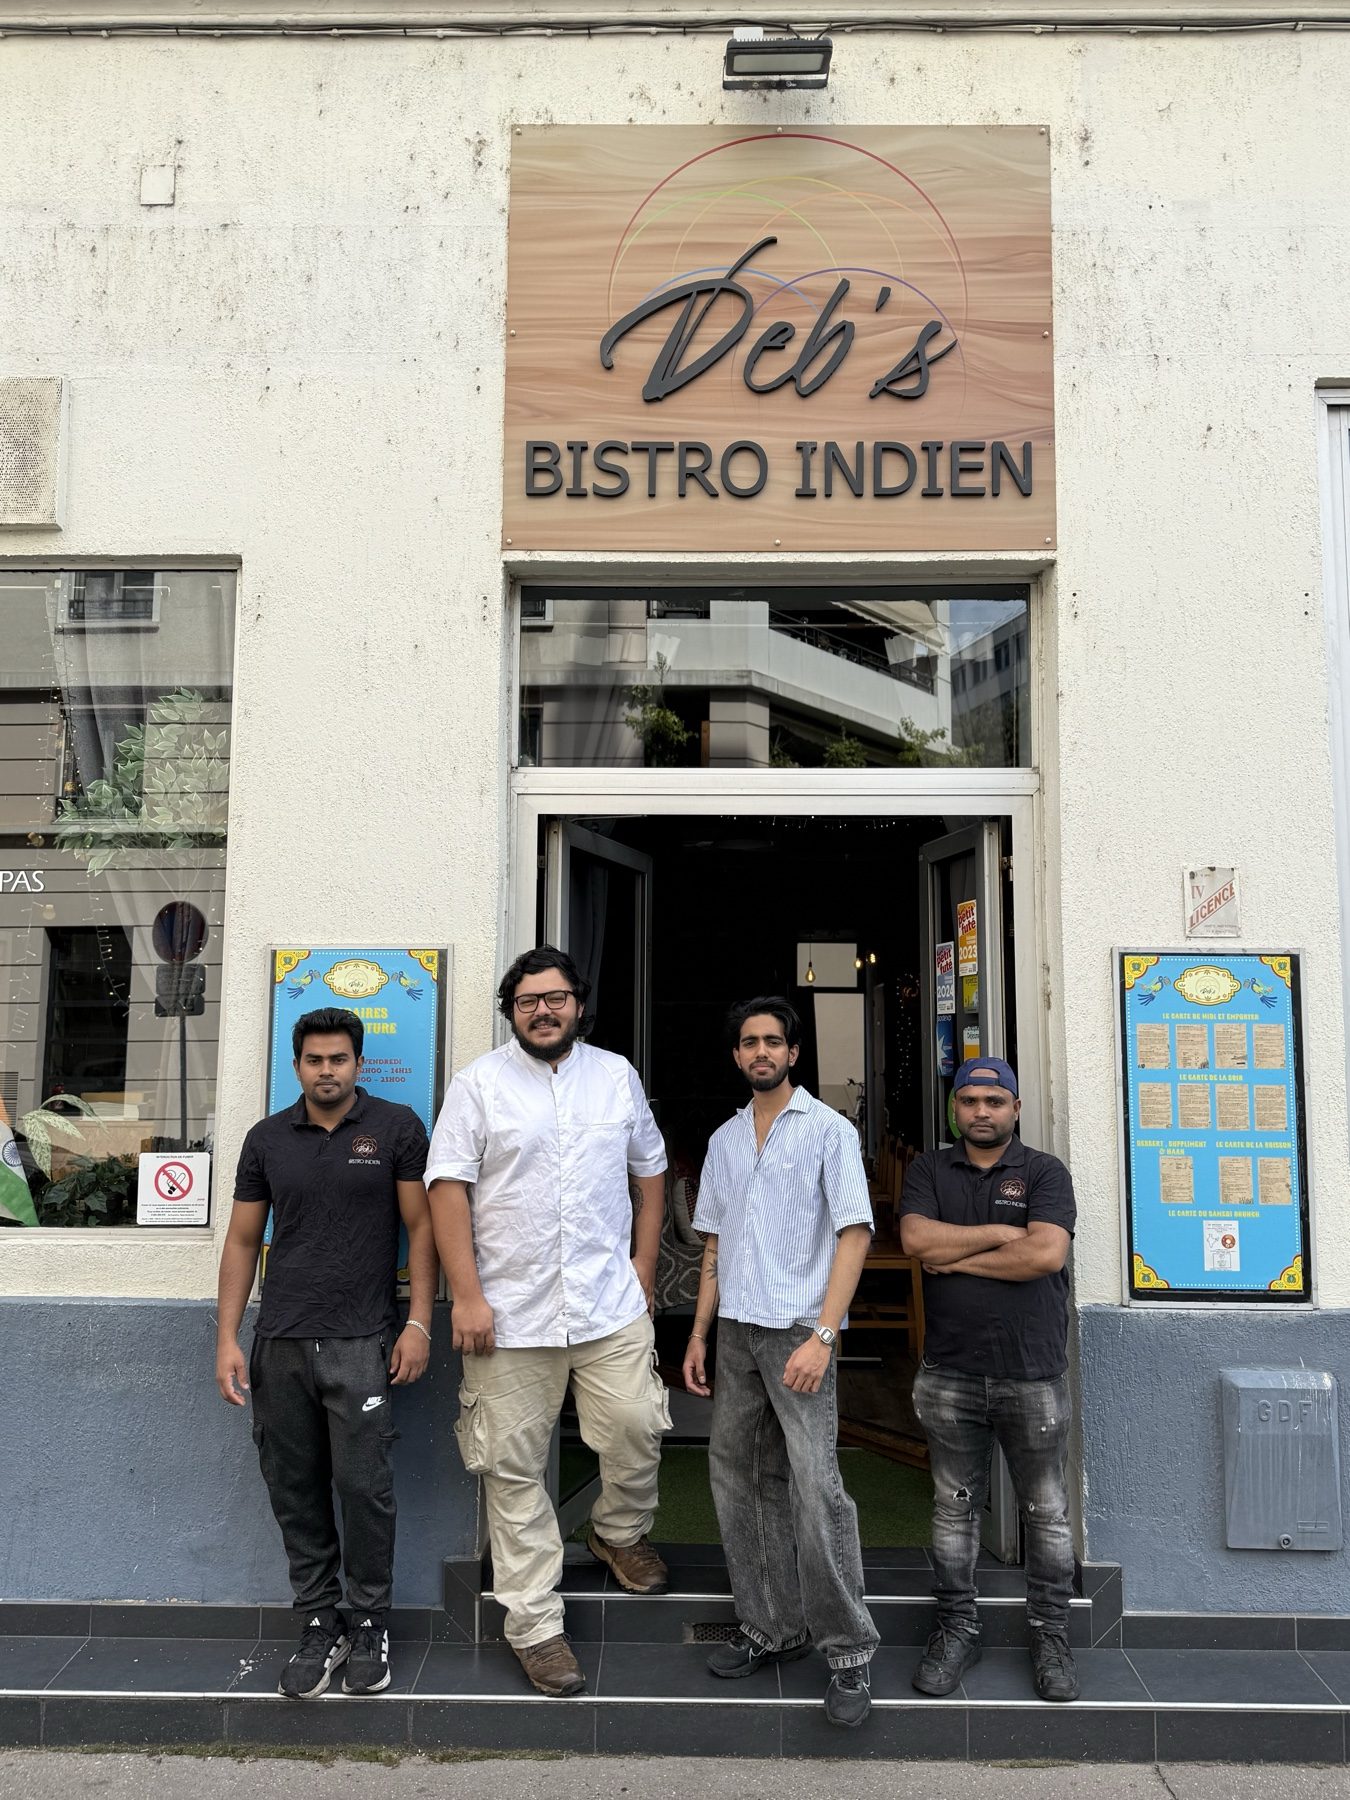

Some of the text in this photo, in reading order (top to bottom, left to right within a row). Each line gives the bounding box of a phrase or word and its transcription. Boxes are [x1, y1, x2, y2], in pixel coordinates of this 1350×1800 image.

[601, 236, 958, 404] Deb's
[525, 441, 1033, 500] BISTRO INDIEN
[1191, 885, 1205, 900] IV
[1189, 881, 1235, 928] LICENCE
[958, 905, 975, 928] petit
[961, 917, 976, 935] futé
[959, 944, 977, 960] 2023
[940, 959, 953, 975] futé
[937, 984, 955, 998] 2024
[352, 1007, 388, 1019] AIRES
[365, 1022, 397, 1034] TURE
[1257, 1400, 1312, 1423] GDF
